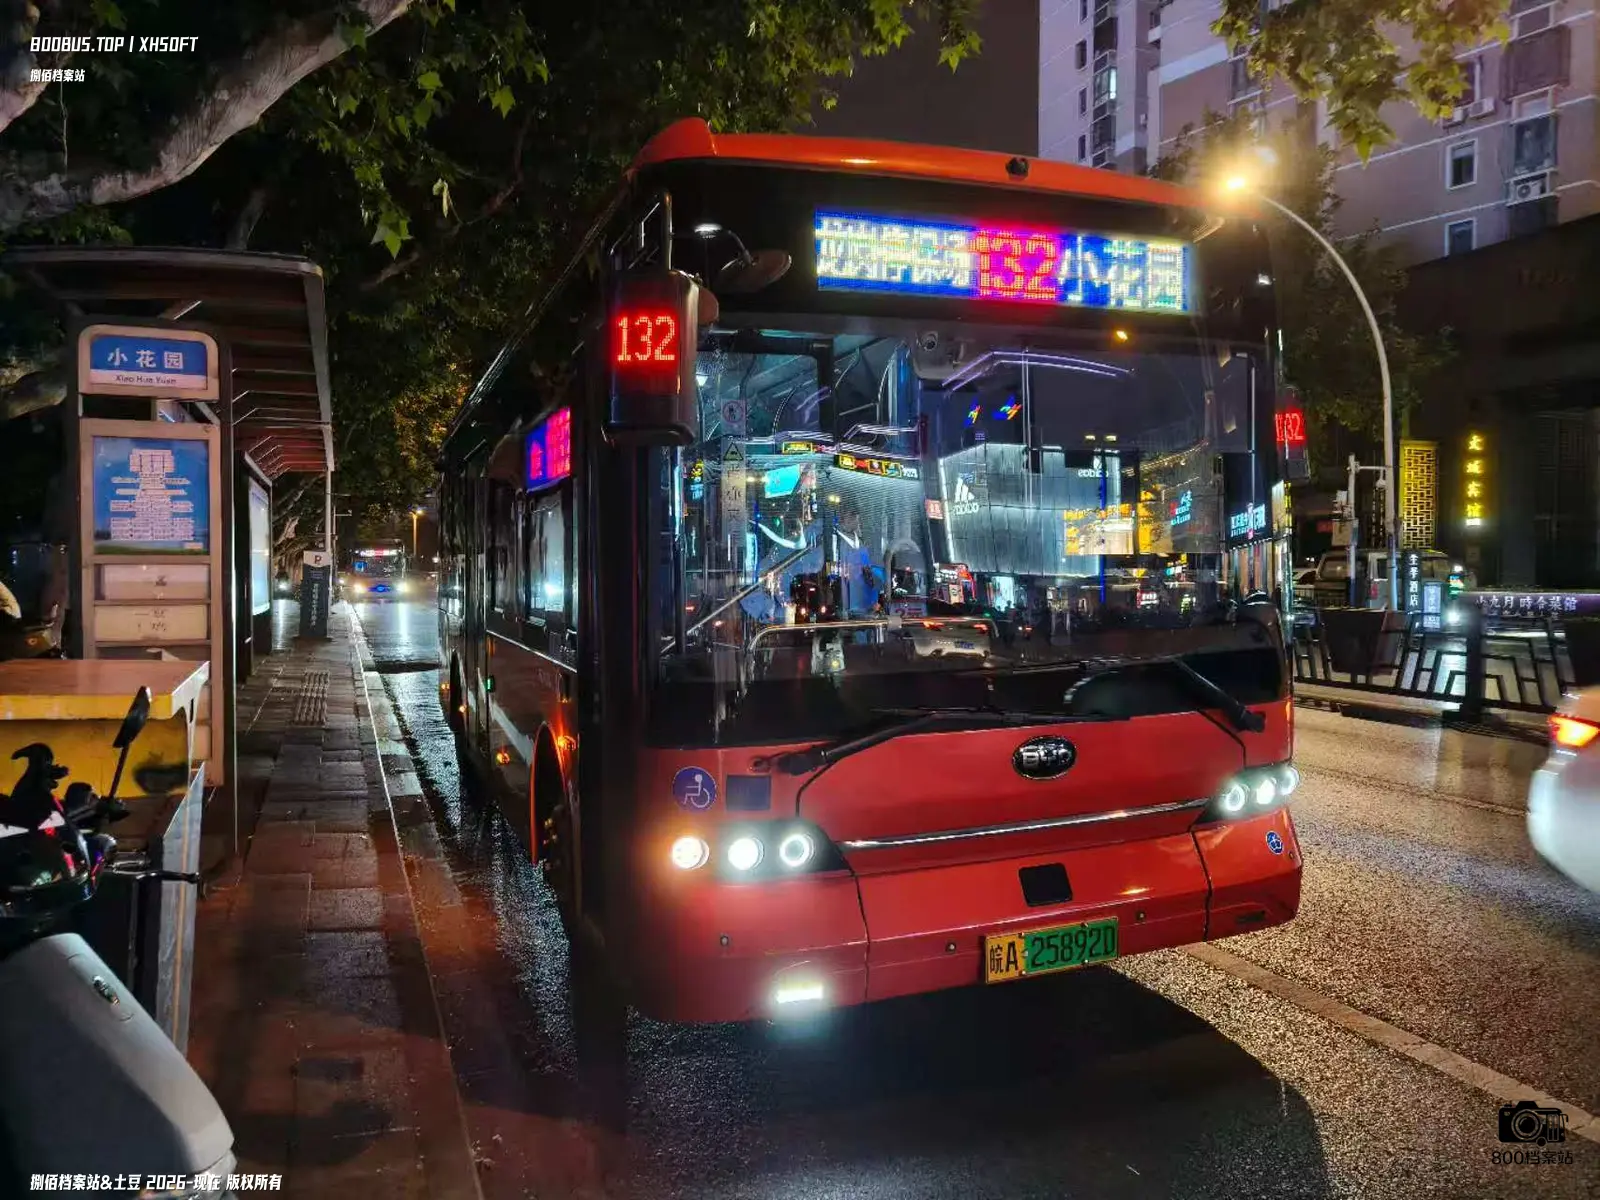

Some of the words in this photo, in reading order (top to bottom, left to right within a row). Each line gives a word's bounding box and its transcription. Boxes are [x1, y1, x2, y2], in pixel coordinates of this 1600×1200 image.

[616, 315, 675, 361] 132
[107, 347, 183, 369] 小花园
[116, 374, 134, 382] Xiao
[156, 377, 177, 385] Yuan
[989, 940, 1019, 973] 皖A
